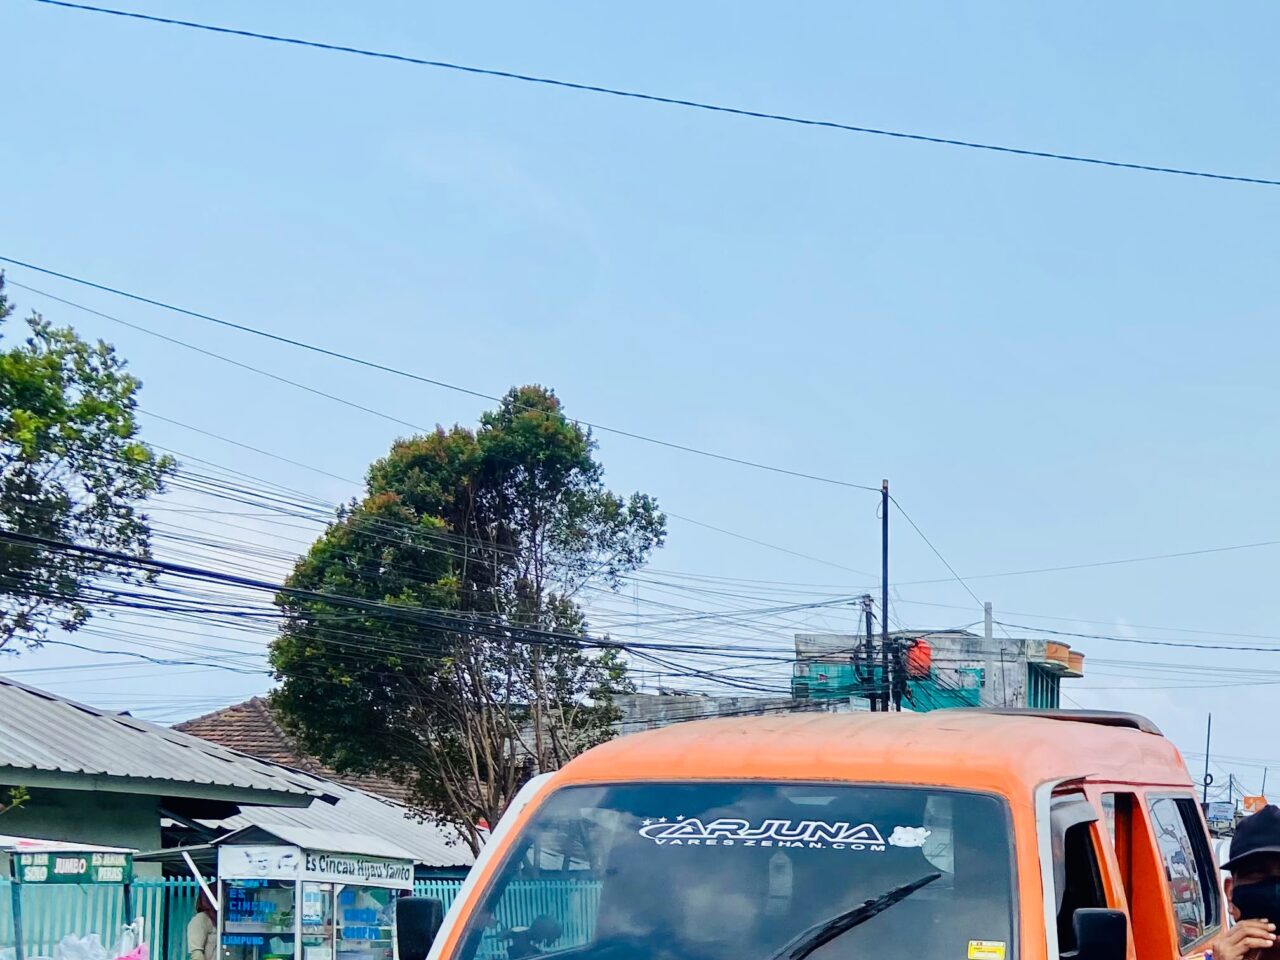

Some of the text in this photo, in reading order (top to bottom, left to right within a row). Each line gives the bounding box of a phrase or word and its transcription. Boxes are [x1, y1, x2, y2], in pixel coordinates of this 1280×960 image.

[660, 818, 886, 845] ARJUNA
[655, 839, 735, 847] VARES
[54, 858, 86, 874] JUMBO
[305, 853, 410, 881] Es Cincau Hijau Yanto
